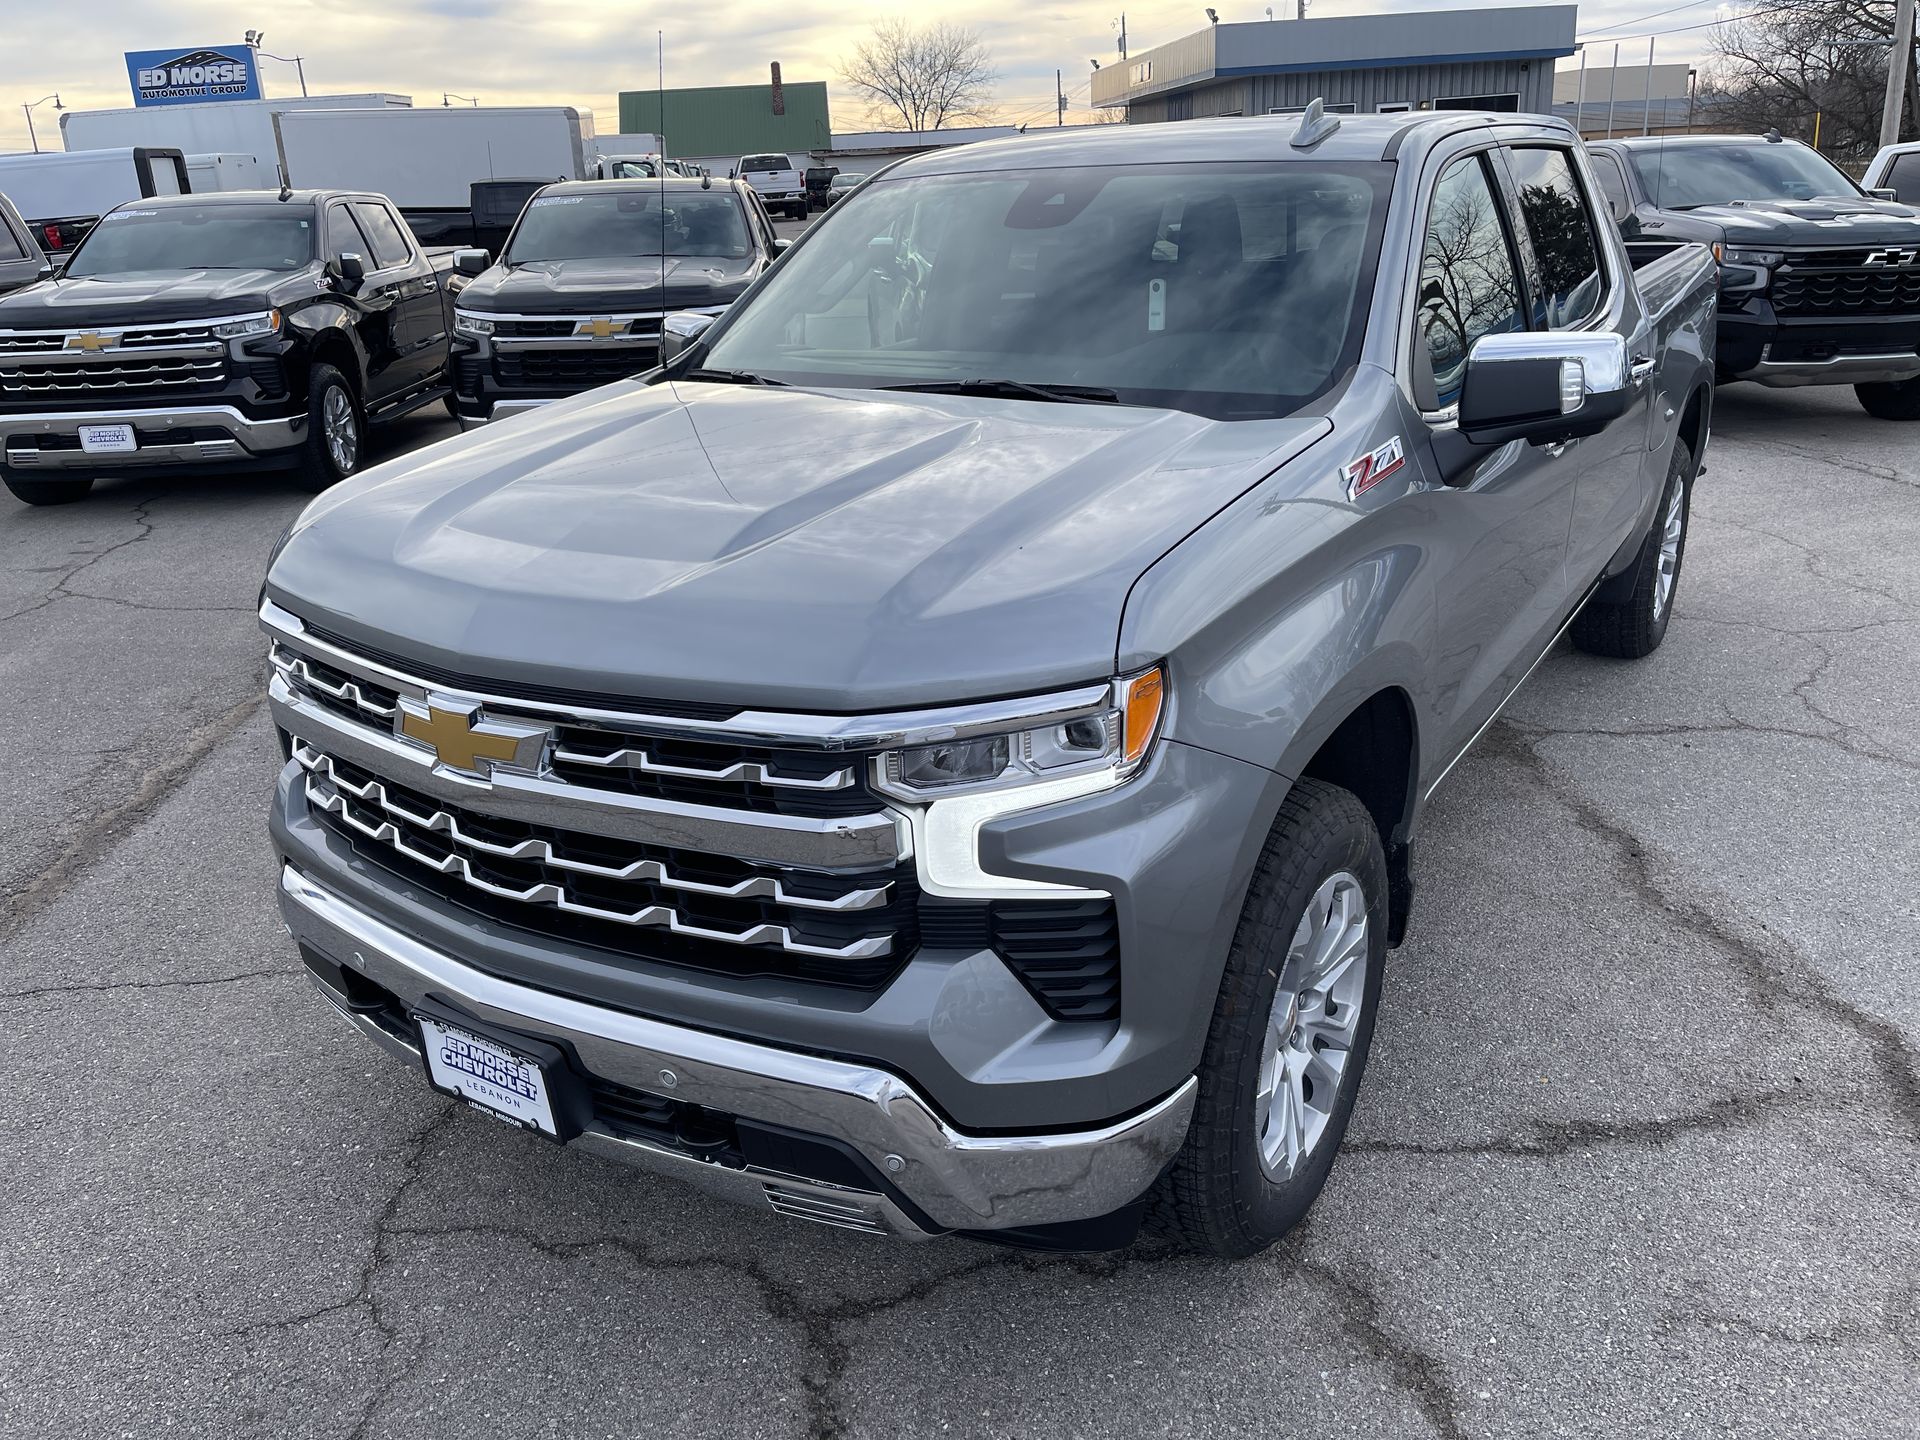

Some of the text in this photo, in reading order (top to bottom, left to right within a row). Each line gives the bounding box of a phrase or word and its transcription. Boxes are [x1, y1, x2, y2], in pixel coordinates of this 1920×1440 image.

[139, 63, 247, 87] ED MORSE
[141, 85, 247, 99] AUTOMOTIVE GROUP
[446, 1035, 530, 1082] ED MORSE
[440, 1047, 537, 1101] CHEVROLET
[466, 1079, 521, 1109] LEBANON
[495, 1111, 523, 1129] MISSOURI
